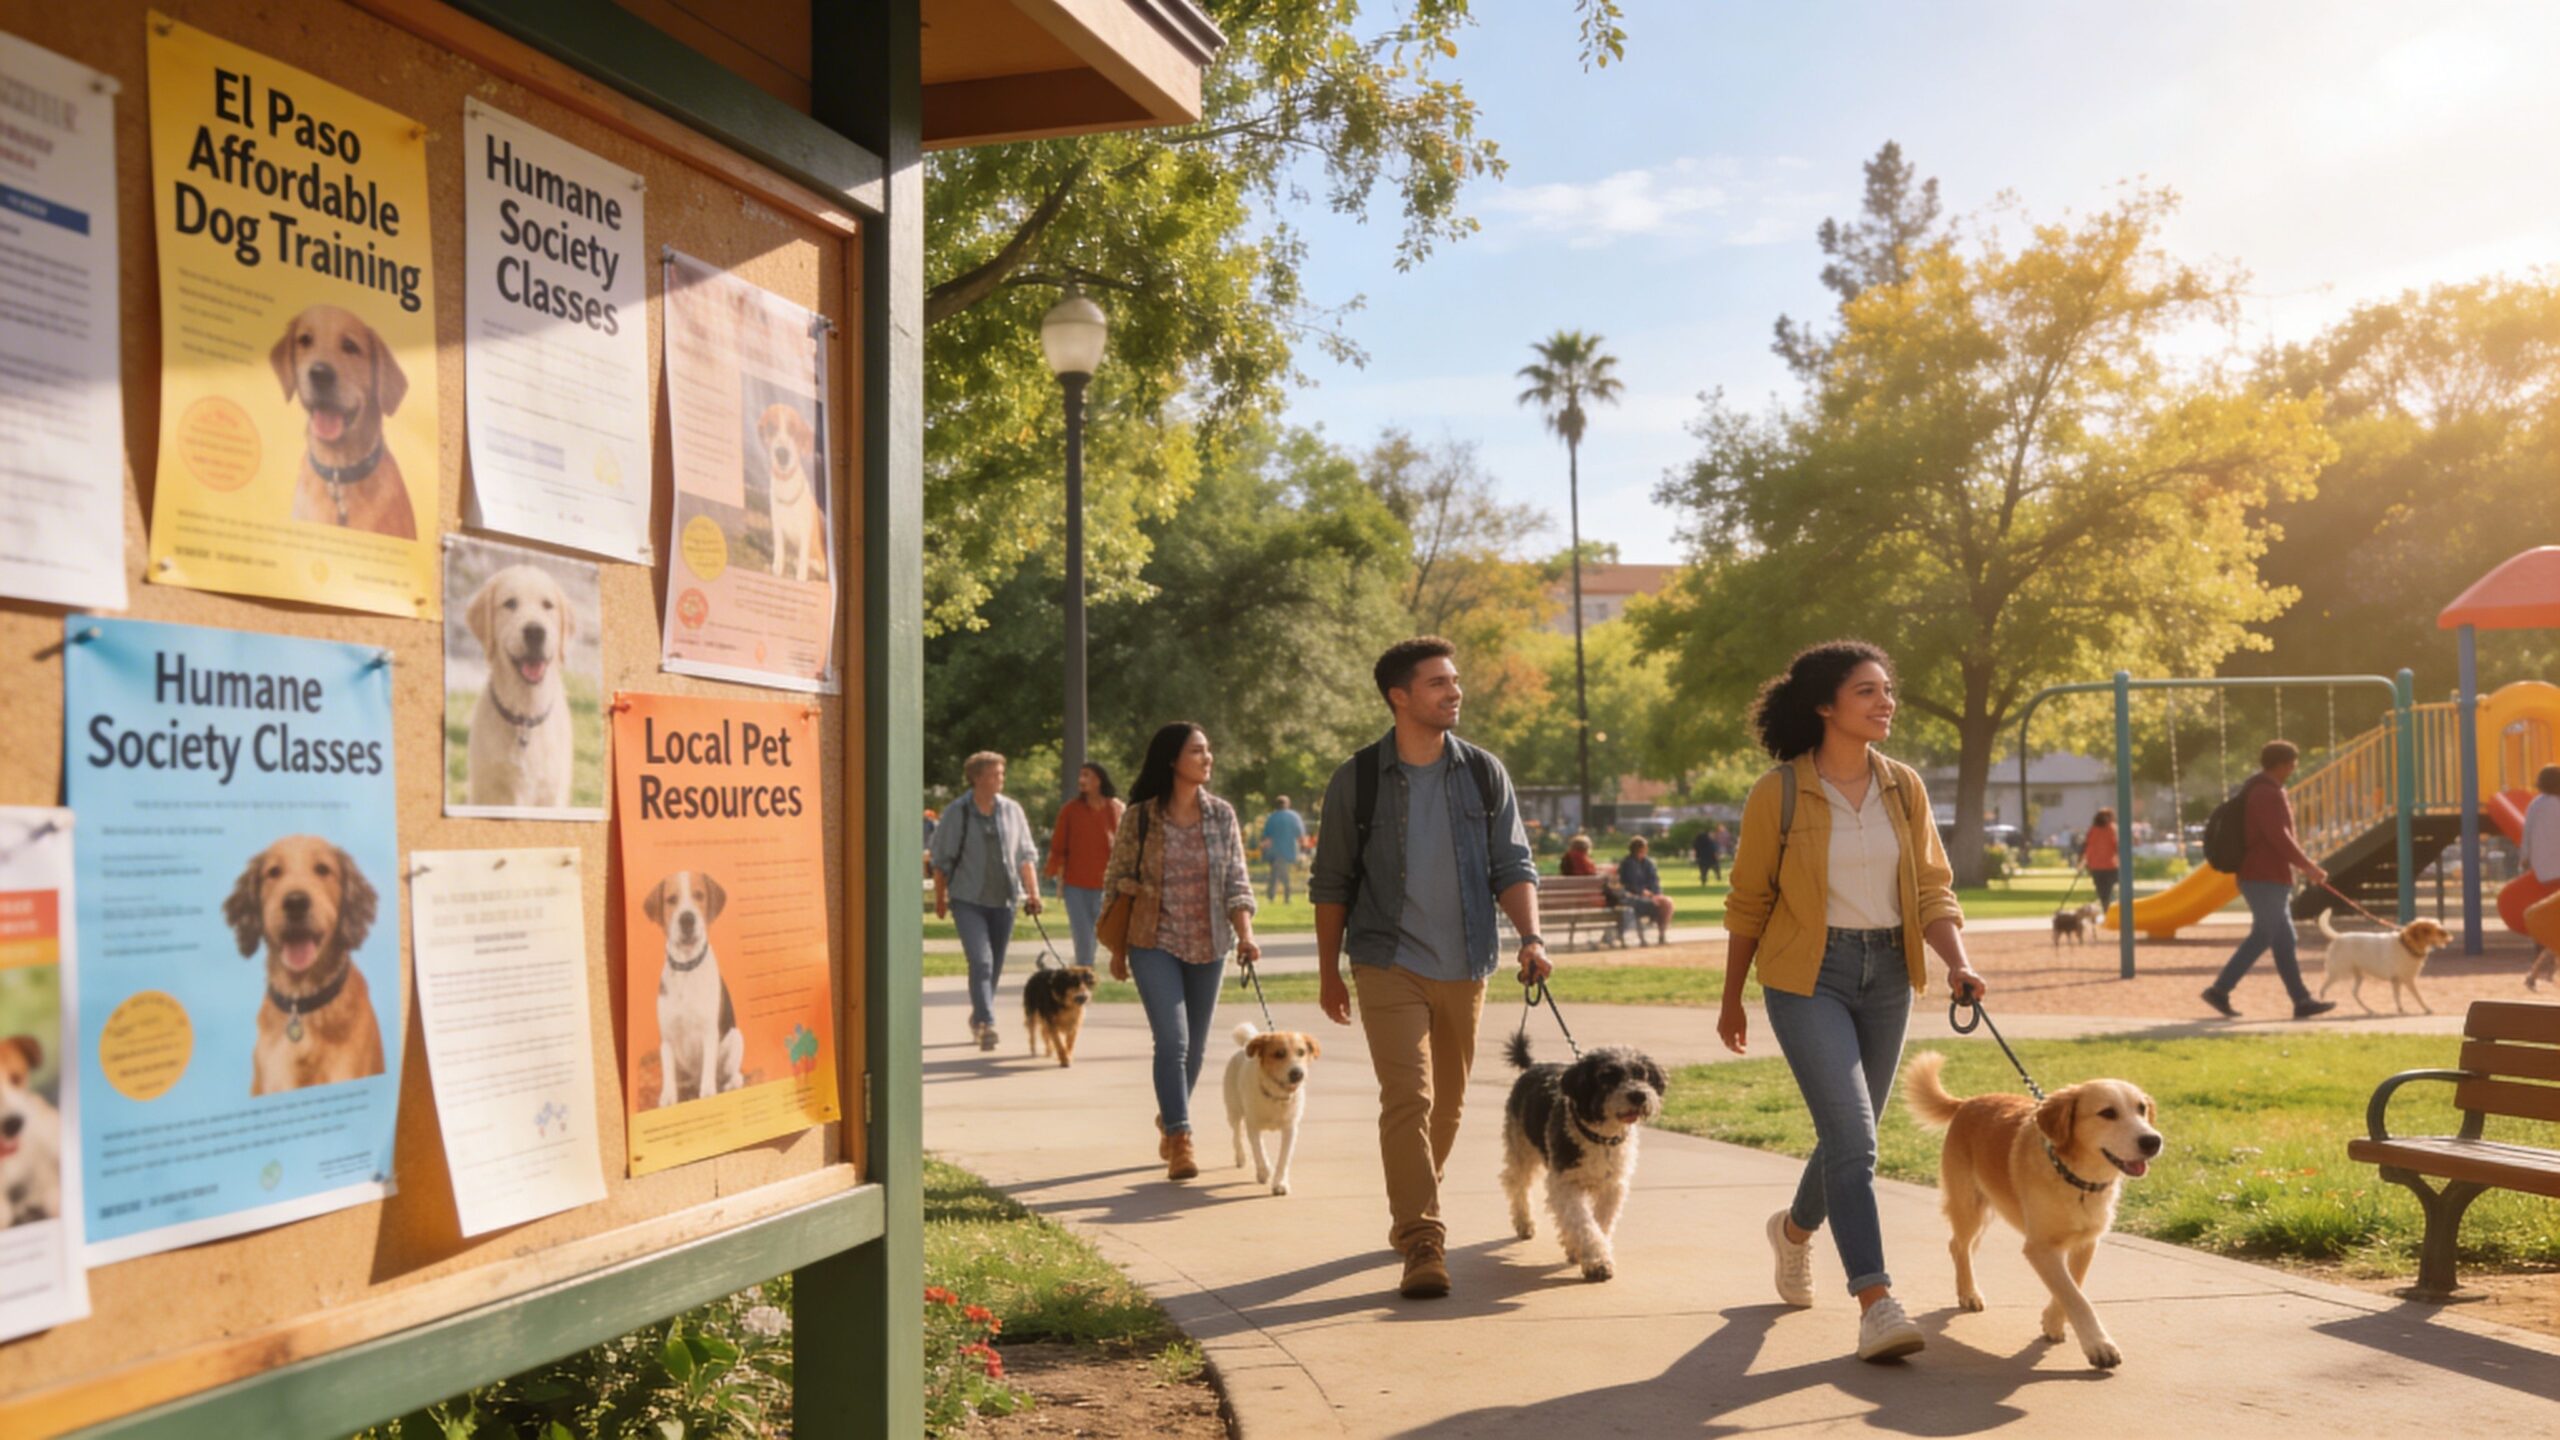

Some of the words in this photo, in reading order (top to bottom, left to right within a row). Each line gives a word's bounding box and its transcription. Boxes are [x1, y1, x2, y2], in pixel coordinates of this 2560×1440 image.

[214, 68, 254, 129] El
[268, 88, 361, 164] Paso
[188, 126, 400, 236] Affordable
[486, 135, 622, 230] Humane
[175, 181, 261, 266] Dog
[269, 212, 421, 311] Training
[500, 199, 619, 290] Society
[497, 256, 619, 336] Classes
[155, 652, 322, 713] Humane
[88, 715, 243, 784] Society
[253, 722, 382, 775] Classes
[645, 717, 731, 765] Local
[742, 722, 792, 767] Pet
[641, 775, 802, 820] Resources
